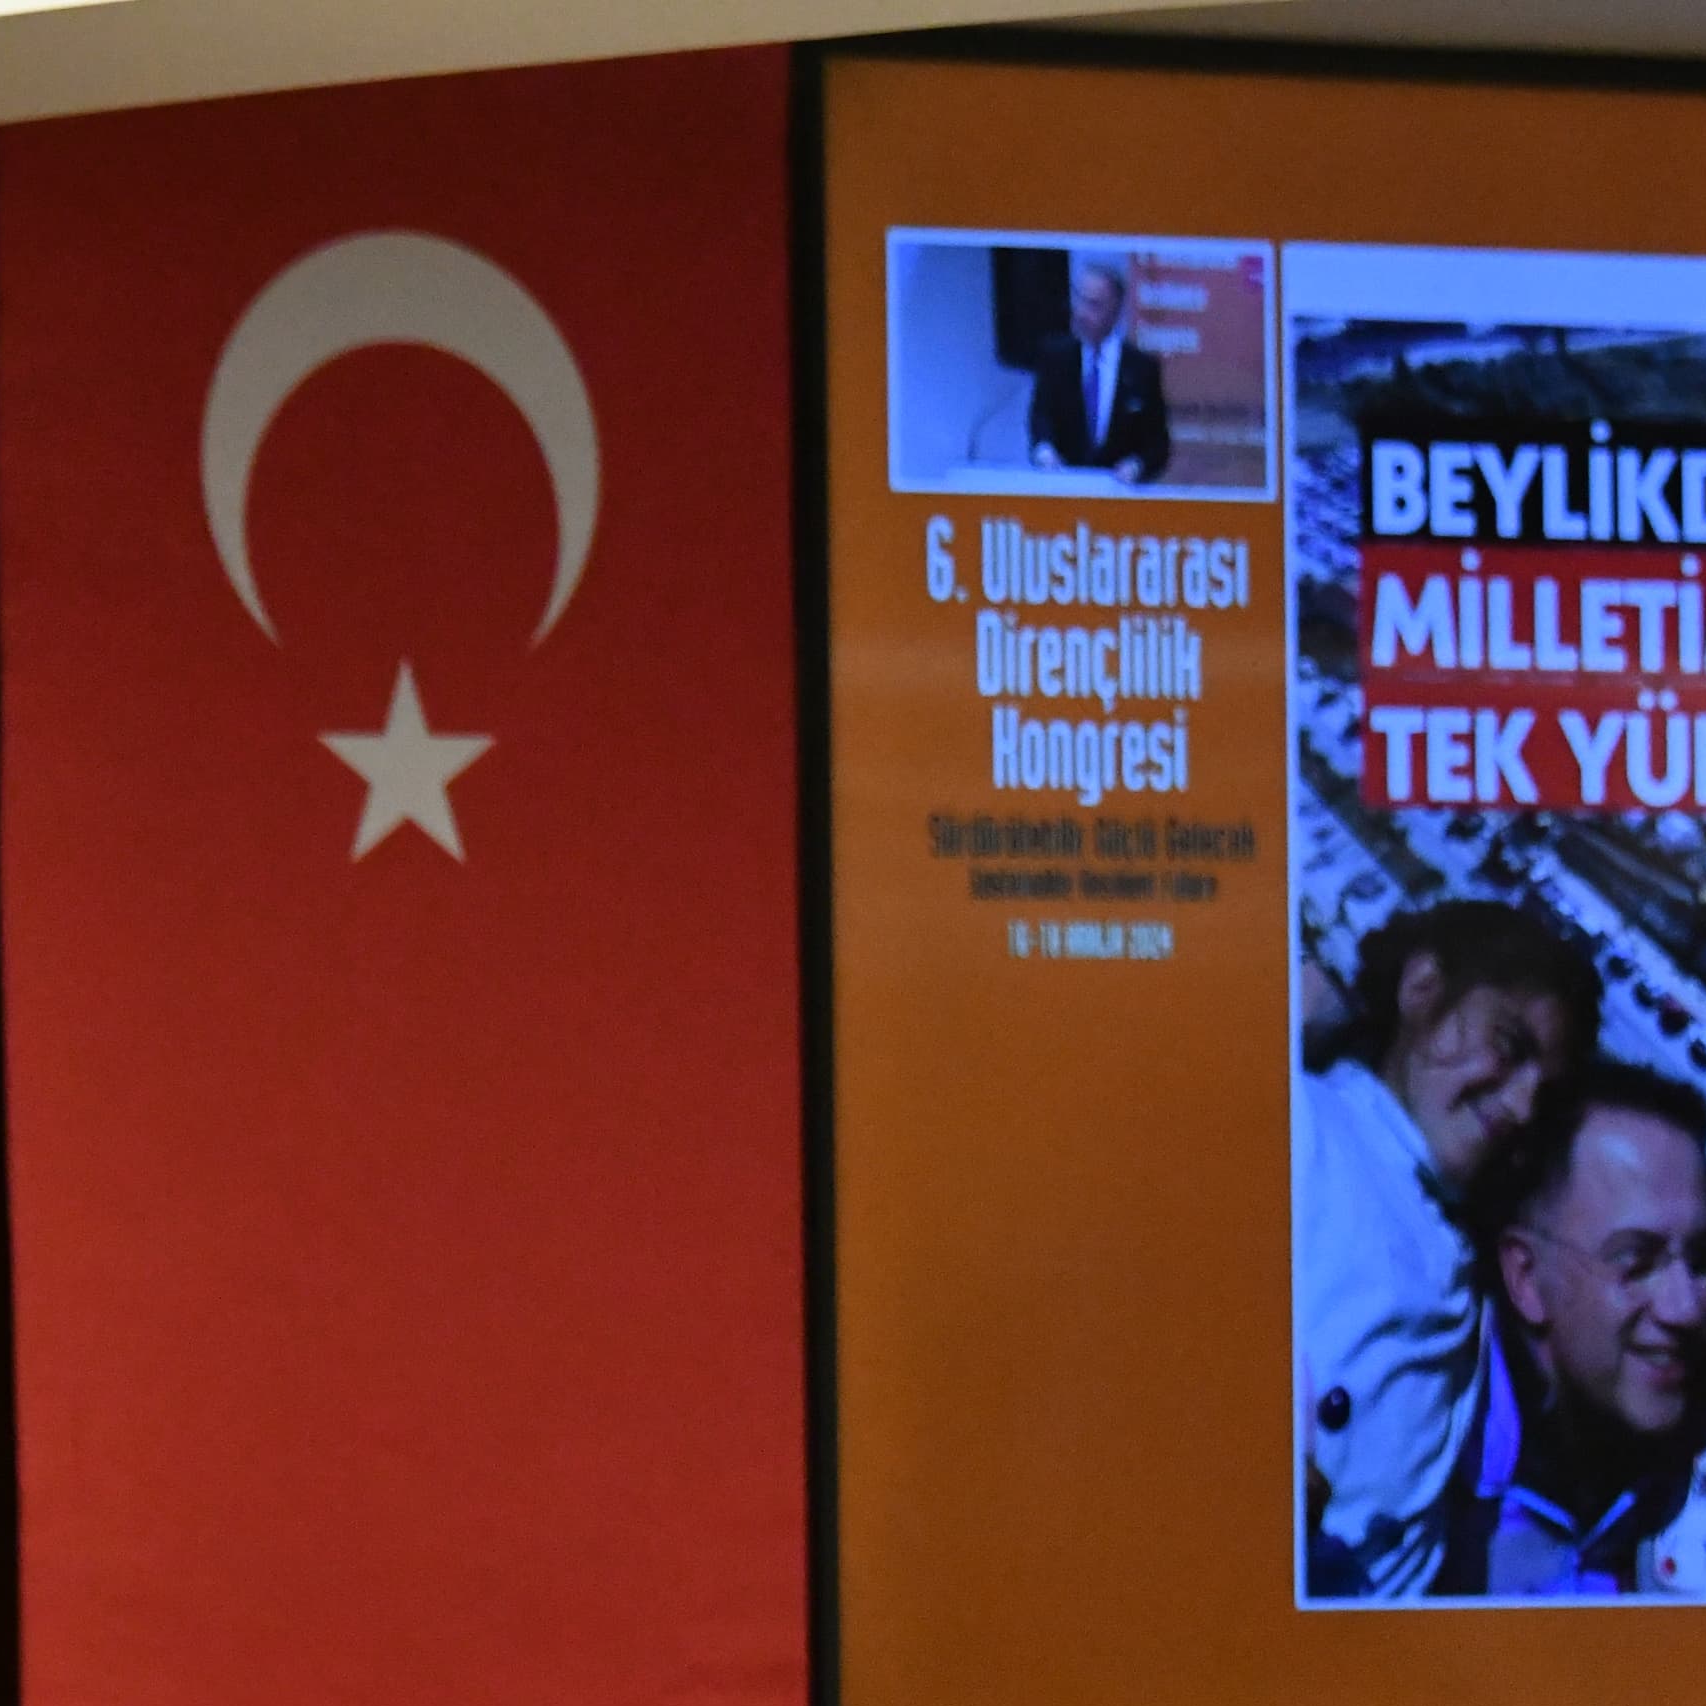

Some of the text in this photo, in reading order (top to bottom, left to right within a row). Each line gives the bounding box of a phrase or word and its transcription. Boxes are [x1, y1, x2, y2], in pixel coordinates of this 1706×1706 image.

[925, 514, 1250, 609] 6. Uluslararası
[975, 608, 1203, 712] Dirençlilik
[992, 706, 1189, 808] Kongresi
[1369, 703, 1539, 806] TEK
